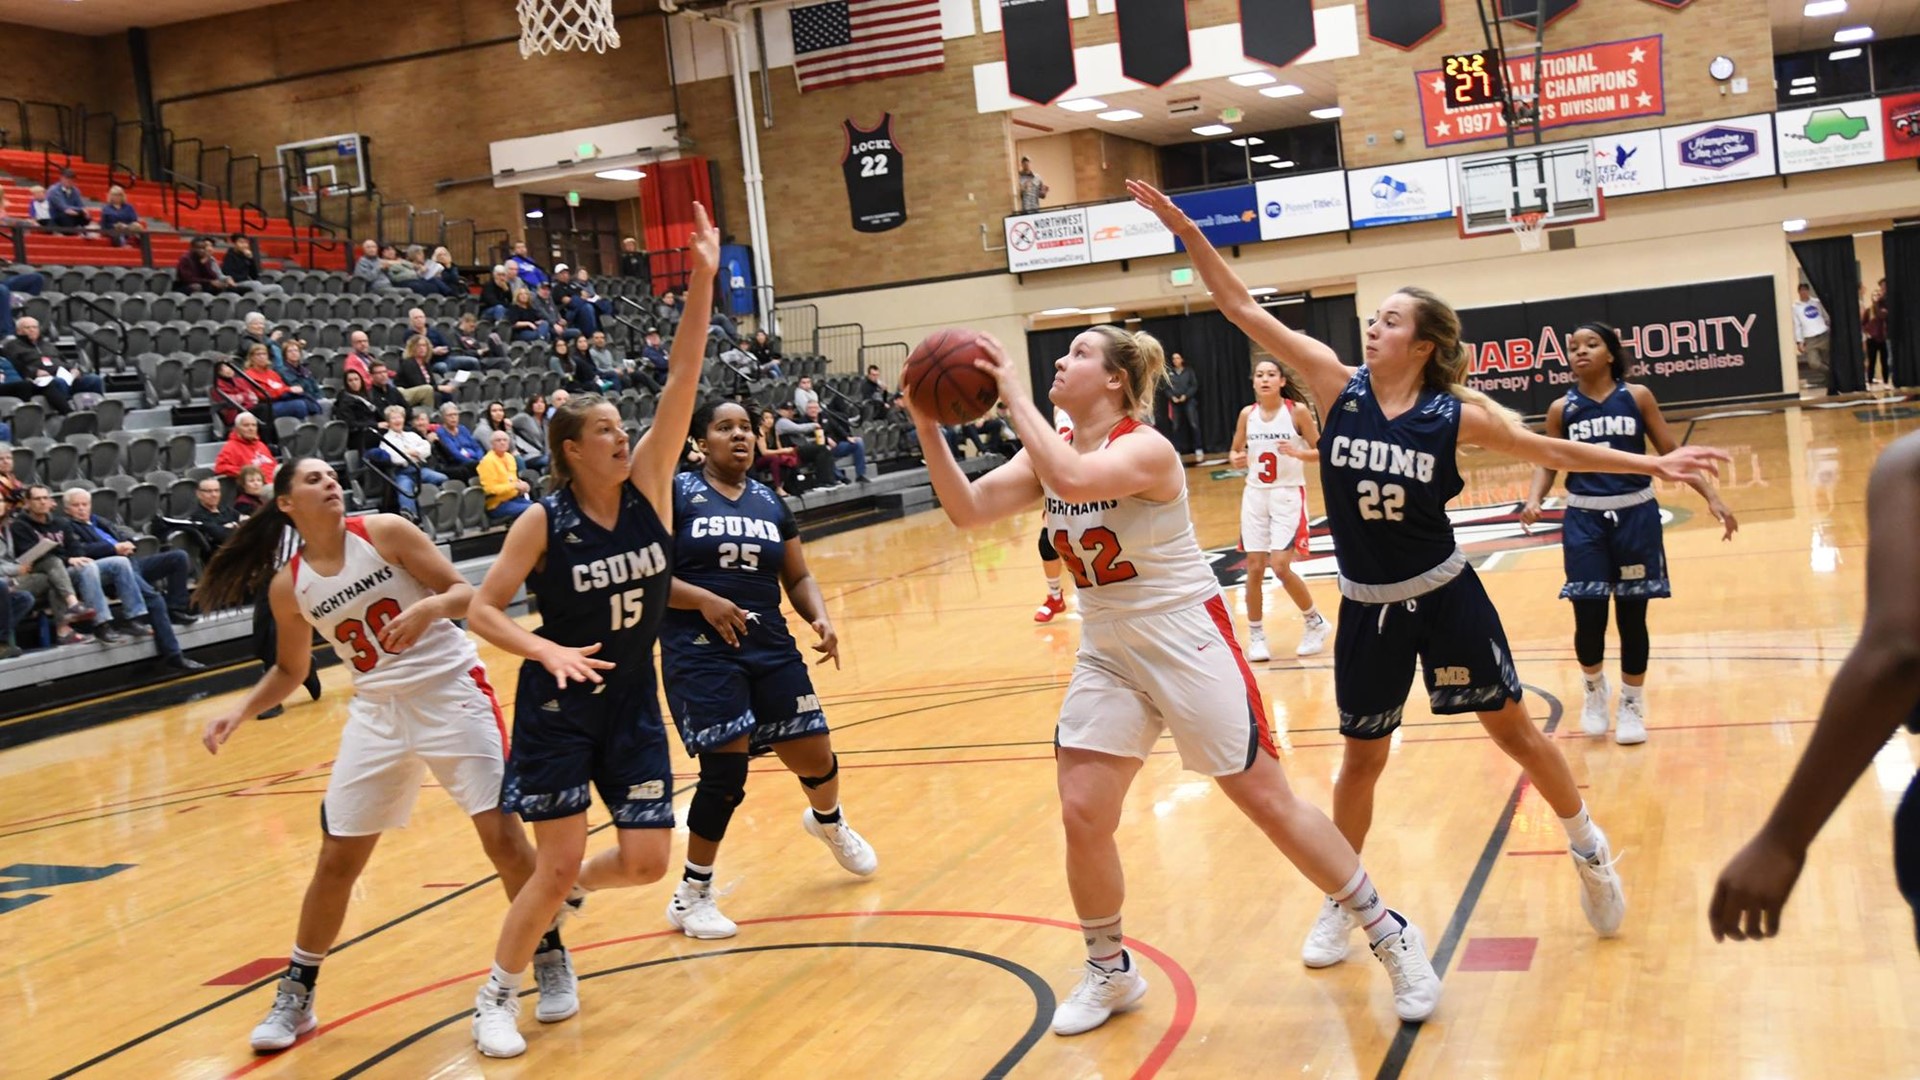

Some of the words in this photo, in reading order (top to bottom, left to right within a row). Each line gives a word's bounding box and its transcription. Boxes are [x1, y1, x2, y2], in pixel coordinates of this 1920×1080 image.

[1455, 71, 1491, 102] 27
[1545, 69, 1639, 99] CHAMPIONS
[1560, 97, 1616, 117] DIVISION
[1620, 94, 1630, 109] II
[1456, 112, 1492, 135] 1997
[852, 139, 892, 155] LOCKE
[860, 153, 889, 178] 22
[1575, 165, 1618, 180] UNTED
[1582, 170, 1638, 186] HRITAGE
[1034, 213, 1083, 229] NORTHWEST
[1035, 226, 1084, 241] CHRISTIAN
[1467, 374, 1530, 392] therapy
[1548, 369, 1579, 385] bac
[1654, 352, 1745, 377] specialists
[1568, 415, 1636, 441] CSUMB
[1258, 451, 1277, 484] 3
[1330, 435, 1435, 484] CSUMB
[1356, 479, 1405, 521] 22
[691, 515, 781, 543] CSUMB
[718, 542, 762, 571] 25
[1620, 564, 1645, 580] MB
[310, 565, 393, 620] NIGHTHAWKS
[609, 587, 644, 631] 15
[1434, 666, 1471, 686] MB
[627, 779, 665, 800] MB
